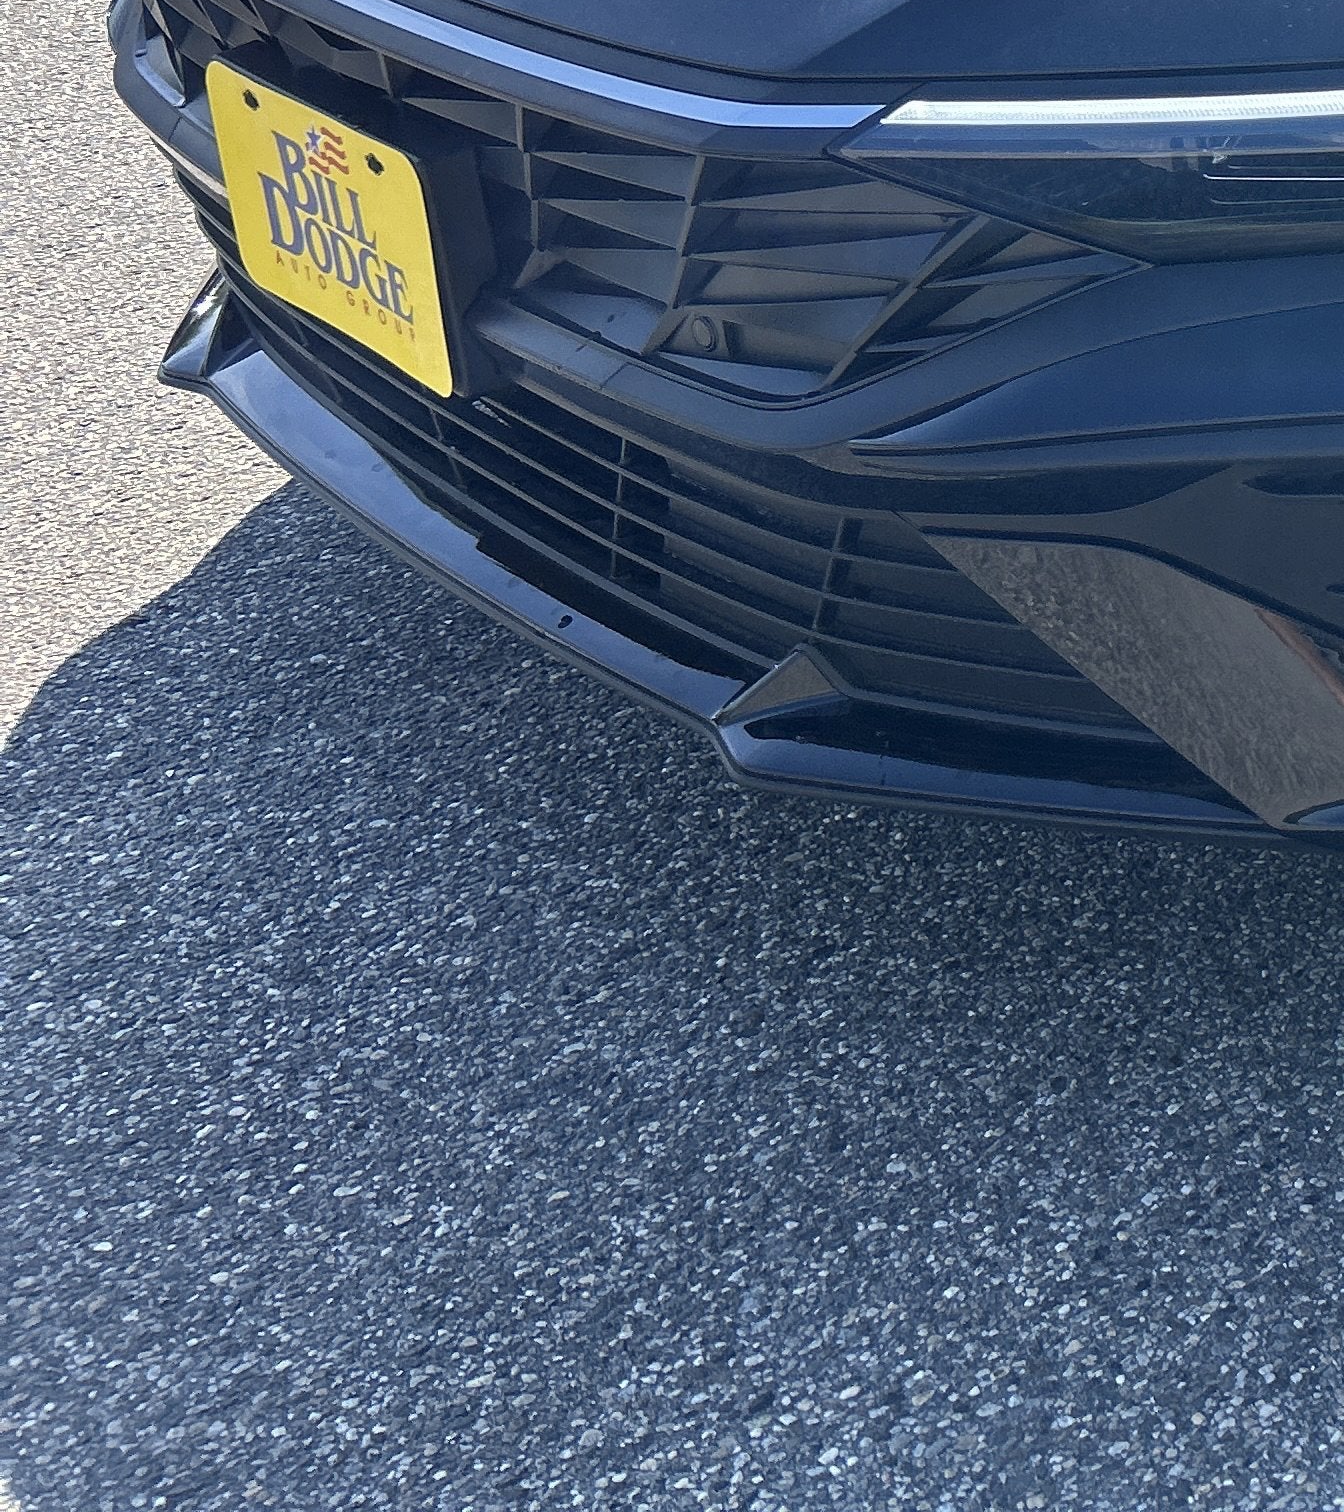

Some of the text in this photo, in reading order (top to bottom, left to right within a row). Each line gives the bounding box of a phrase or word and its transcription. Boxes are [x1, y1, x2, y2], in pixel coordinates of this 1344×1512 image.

[257, 171, 414, 326] DODGE
[271, 130, 377, 252] BILL
[275, 249, 416, 343] AUTO GROUP
